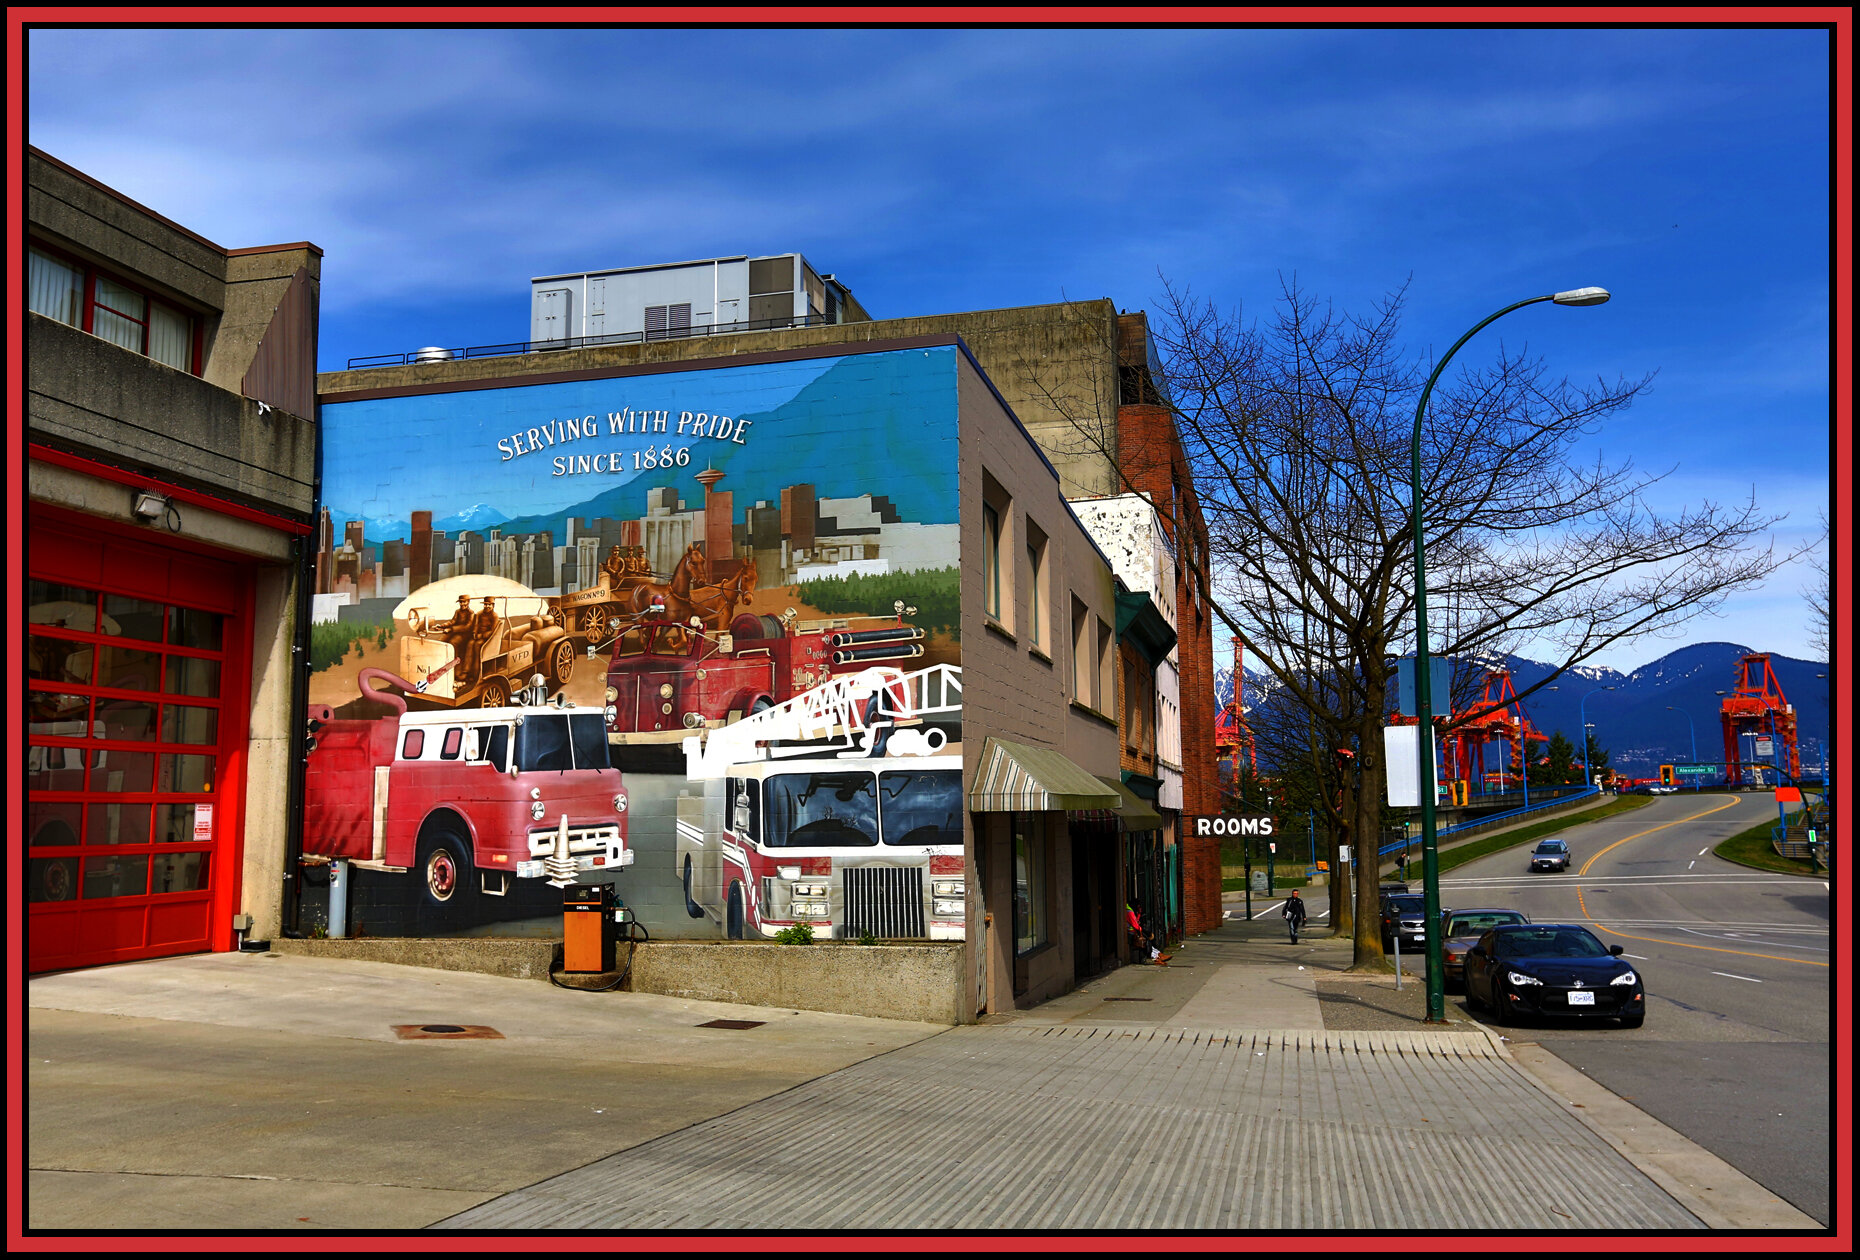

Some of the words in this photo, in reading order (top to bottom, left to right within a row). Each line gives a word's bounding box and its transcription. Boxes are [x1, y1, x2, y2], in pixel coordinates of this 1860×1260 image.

[497, 415, 599, 462] SERVING
[608, 405, 669, 435] WITH
[677, 411, 753, 446] PRIDE
[552, 452, 625, 477] SINCE
[632, 444, 691, 471] 1886
[1197, 817, 1273, 836] ROOMS
